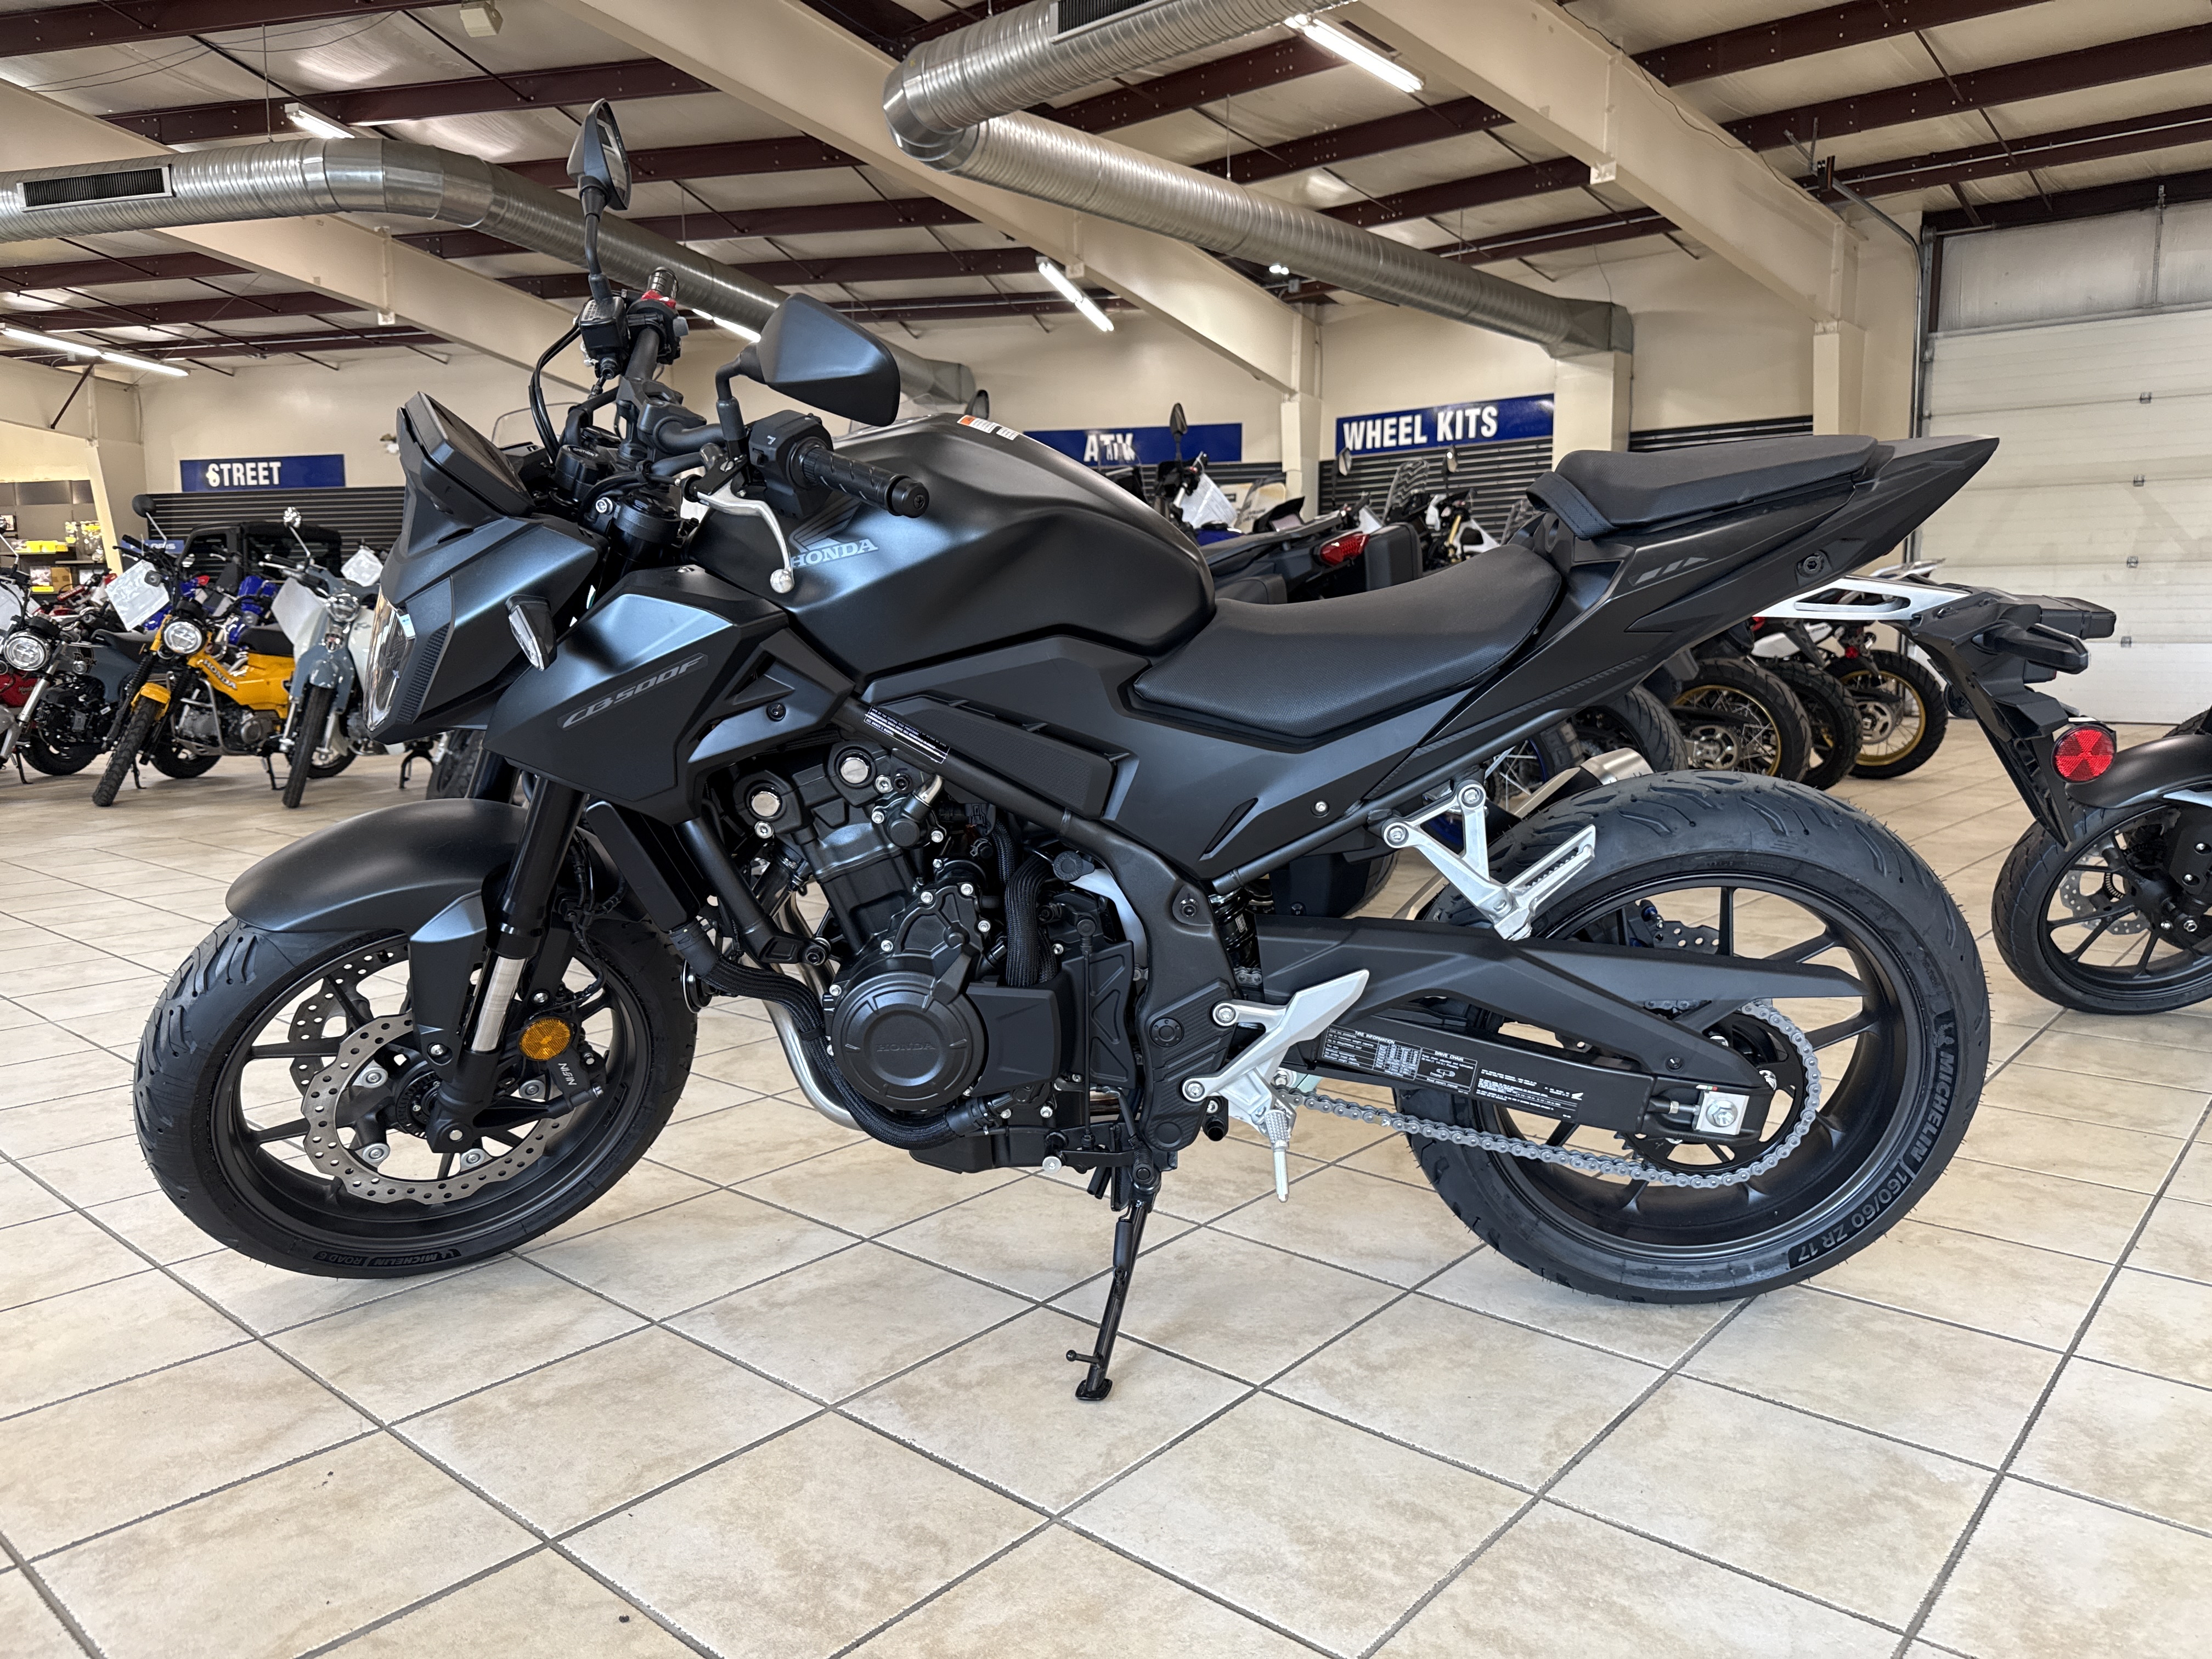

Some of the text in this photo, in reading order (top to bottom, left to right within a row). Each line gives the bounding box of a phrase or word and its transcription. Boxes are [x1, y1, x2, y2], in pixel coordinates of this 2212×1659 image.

[1343, 406, 1498, 451] WHEEL KITS
[206, 461, 281, 487] STREET
[791, 538, 878, 568] HONDA
[203, 659, 238, 690] HONDA
[562, 655, 704, 728] CB500F
[877, 1043, 936, 1052] HONDA
[1910, 1051, 1955, 1163] MICHELIN
[1798, 1171, 1908, 1262] 160/60 ZR 17
[329, 1254, 362, 1266] ROAD
[375, 1252, 439, 1266] MICHELIN
